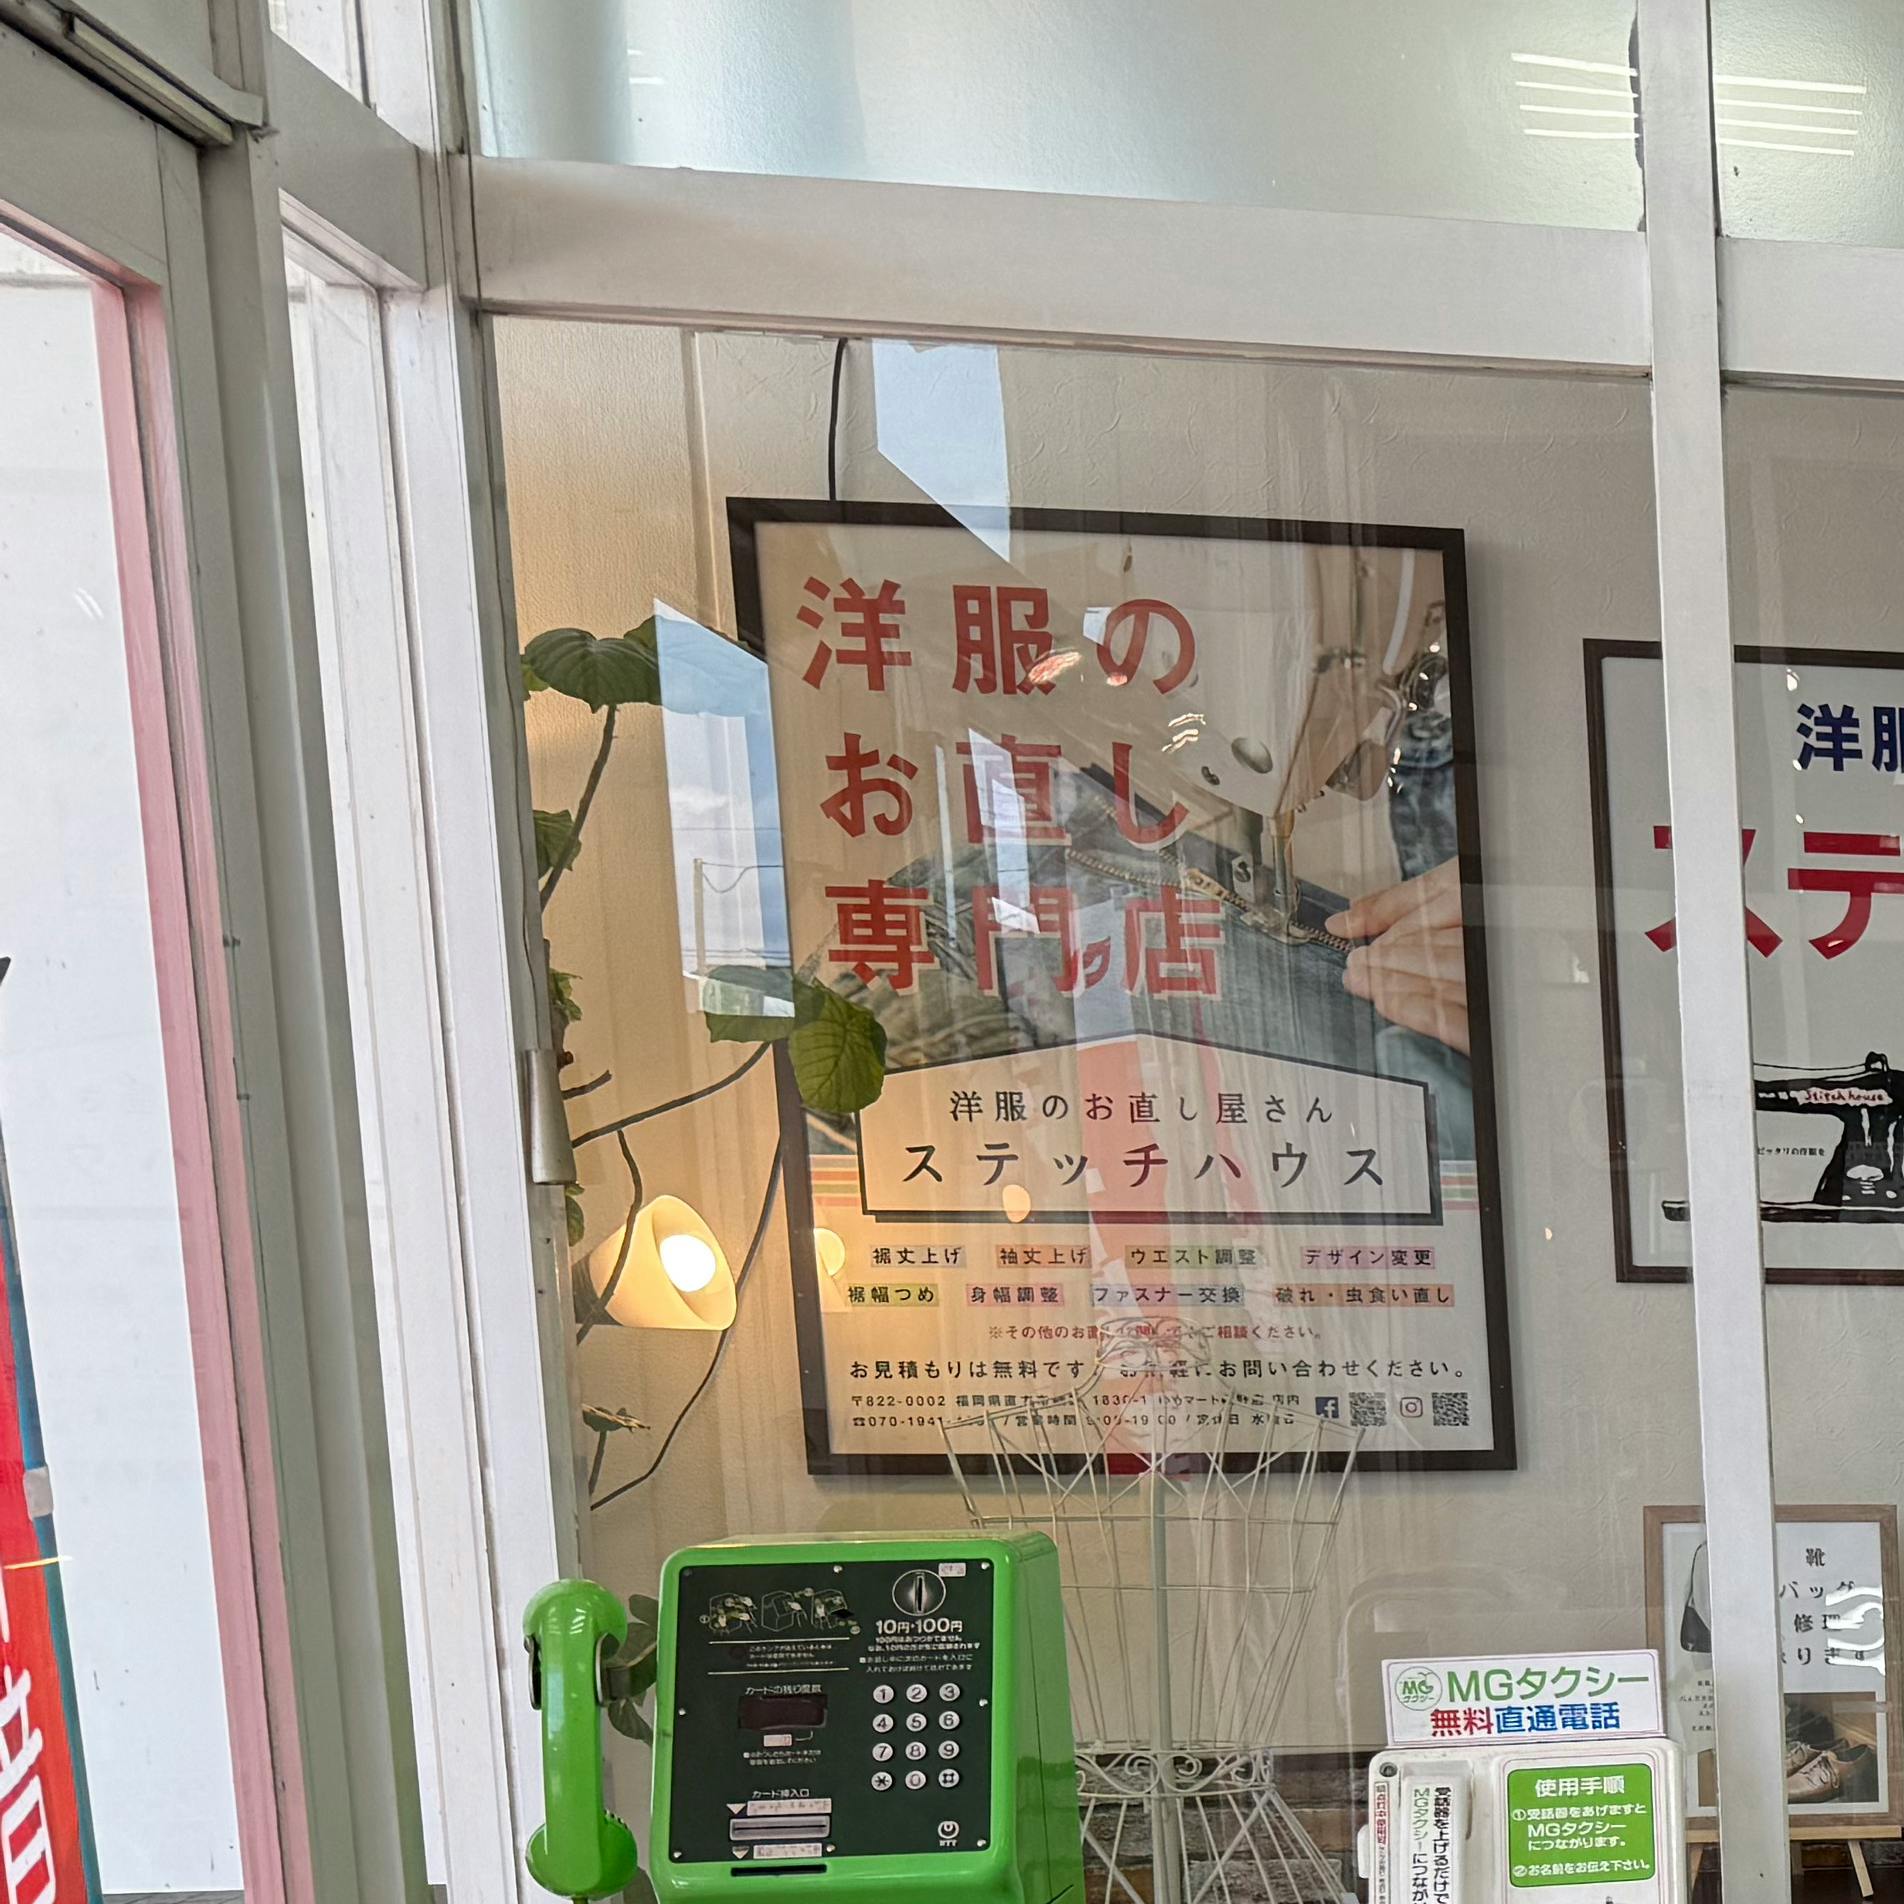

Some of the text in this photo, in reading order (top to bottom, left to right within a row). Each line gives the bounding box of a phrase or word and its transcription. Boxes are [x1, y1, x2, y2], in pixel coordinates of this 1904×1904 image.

[797, 576, 1196, 695] 洋服の
[819, 732, 1190, 844] お直し
[825, 880, 1222, 1000] 専門店
[949, 1090, 1334, 1127] 洋服のお直し屋さん
[902, 1142, 1385, 1189] ステッチハウス
[873, 1246, 1432, 1266] 裾丈上げ 袖丈上げ ウエスト調整 デザイン変更
[848, 1286, 1450, 1304] 裾幅つめ 身幅調整 ファスナー交換 破れ・虫食い直し
[1806, 1548, 1825, 1567] 靴
[1447, 1667, 1649, 1702] MGタクシー
[1430, 1702, 1621, 1737] 無料直通電話
[1535, 1776, 1625, 1797] 使用手順
[1528, 1821, 1627, 1837] MGタクシー
[1529, 1836, 1626, 1851] につながります。
